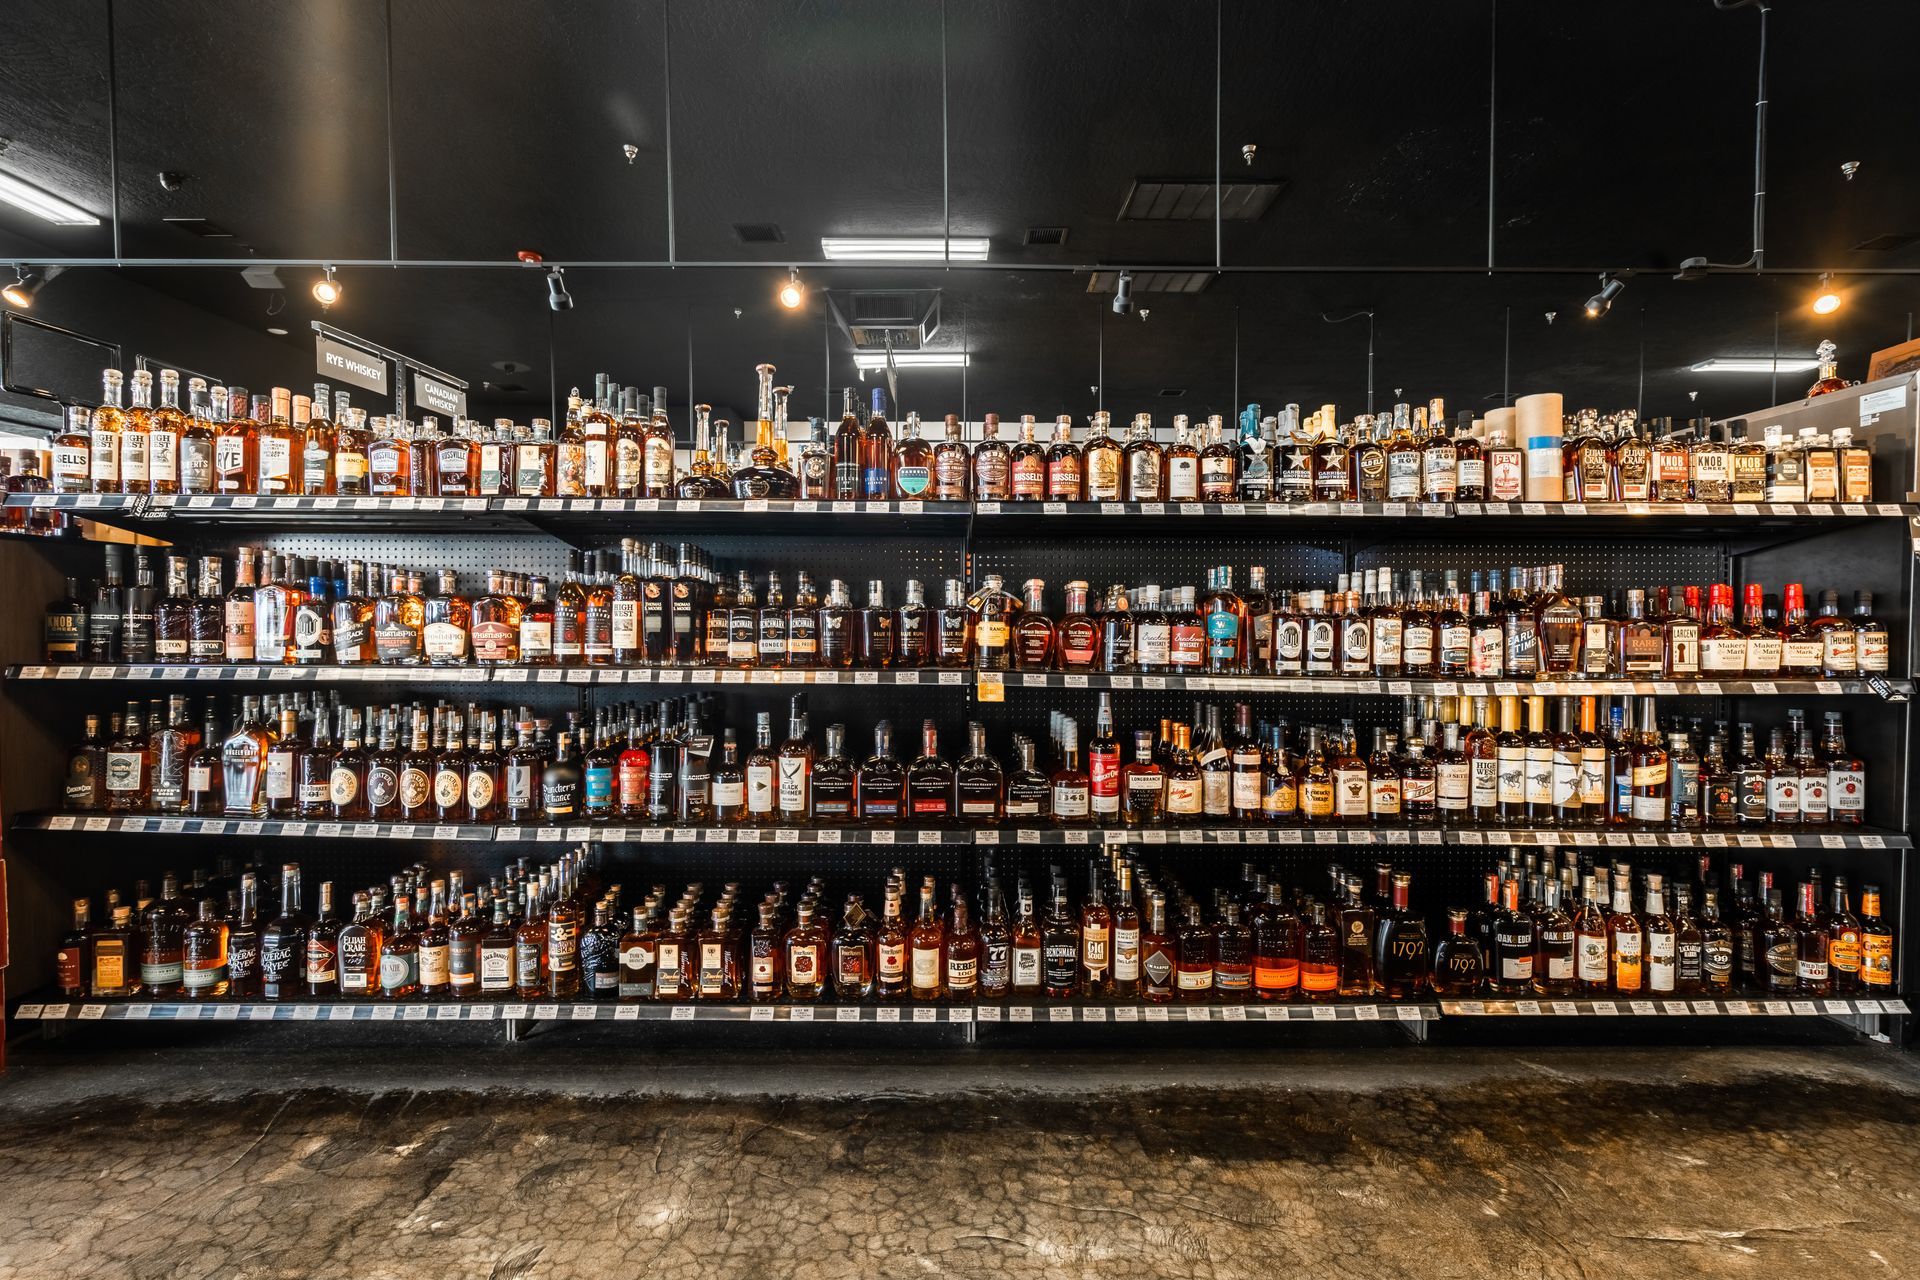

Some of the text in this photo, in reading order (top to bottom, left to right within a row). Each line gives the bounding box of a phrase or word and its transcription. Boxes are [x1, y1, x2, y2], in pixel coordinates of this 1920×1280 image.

[326, 352, 382, 381] RYE WHISKEY
[424, 383, 459, 404] CANADIAN
[428, 396, 457, 412] WHISKEY
[1584, 449, 1606, 457] ELIJAH
[1624, 449, 1645, 457] ELIJAH
[218, 452, 241, 470] RYE
[1496, 454, 1518, 465] FEW
[1584, 456, 1606, 464] CRAIG
[1623, 456, 1645, 464] CRAIG
[1660, 456, 1683, 467] KNOB
[1698, 456, 1722, 467] KNOB
[1735, 458, 1760, 468] KNOB
[48, 616, 73, 628] KNOB
[1507, 628, 1536, 646] EARLY
[1673, 630, 1698, 639] LARCENY
[1631, 638, 1658, 648] RARE
[1868, 677, 1889, 700] LOCAL
[1836, 774, 1863, 786] JIM BEAM
[344, 936, 366, 944] ELIJAH
[1497, 934, 1532, 943] OAK EDEN
[1544, 932, 1558, 940] OAK
[343, 944, 366, 952] CRAIG
[989, 946, 1006, 960] 77
[1046, 948, 1077, 958] BENCHMARK
[1393, 941, 1424, 960] 1792
[1713, 954, 1728, 964] 99
[950, 960, 977, 970] REBEL
[1450, 958, 1476, 974] 1792
[1808, 968, 1825, 976] 101
